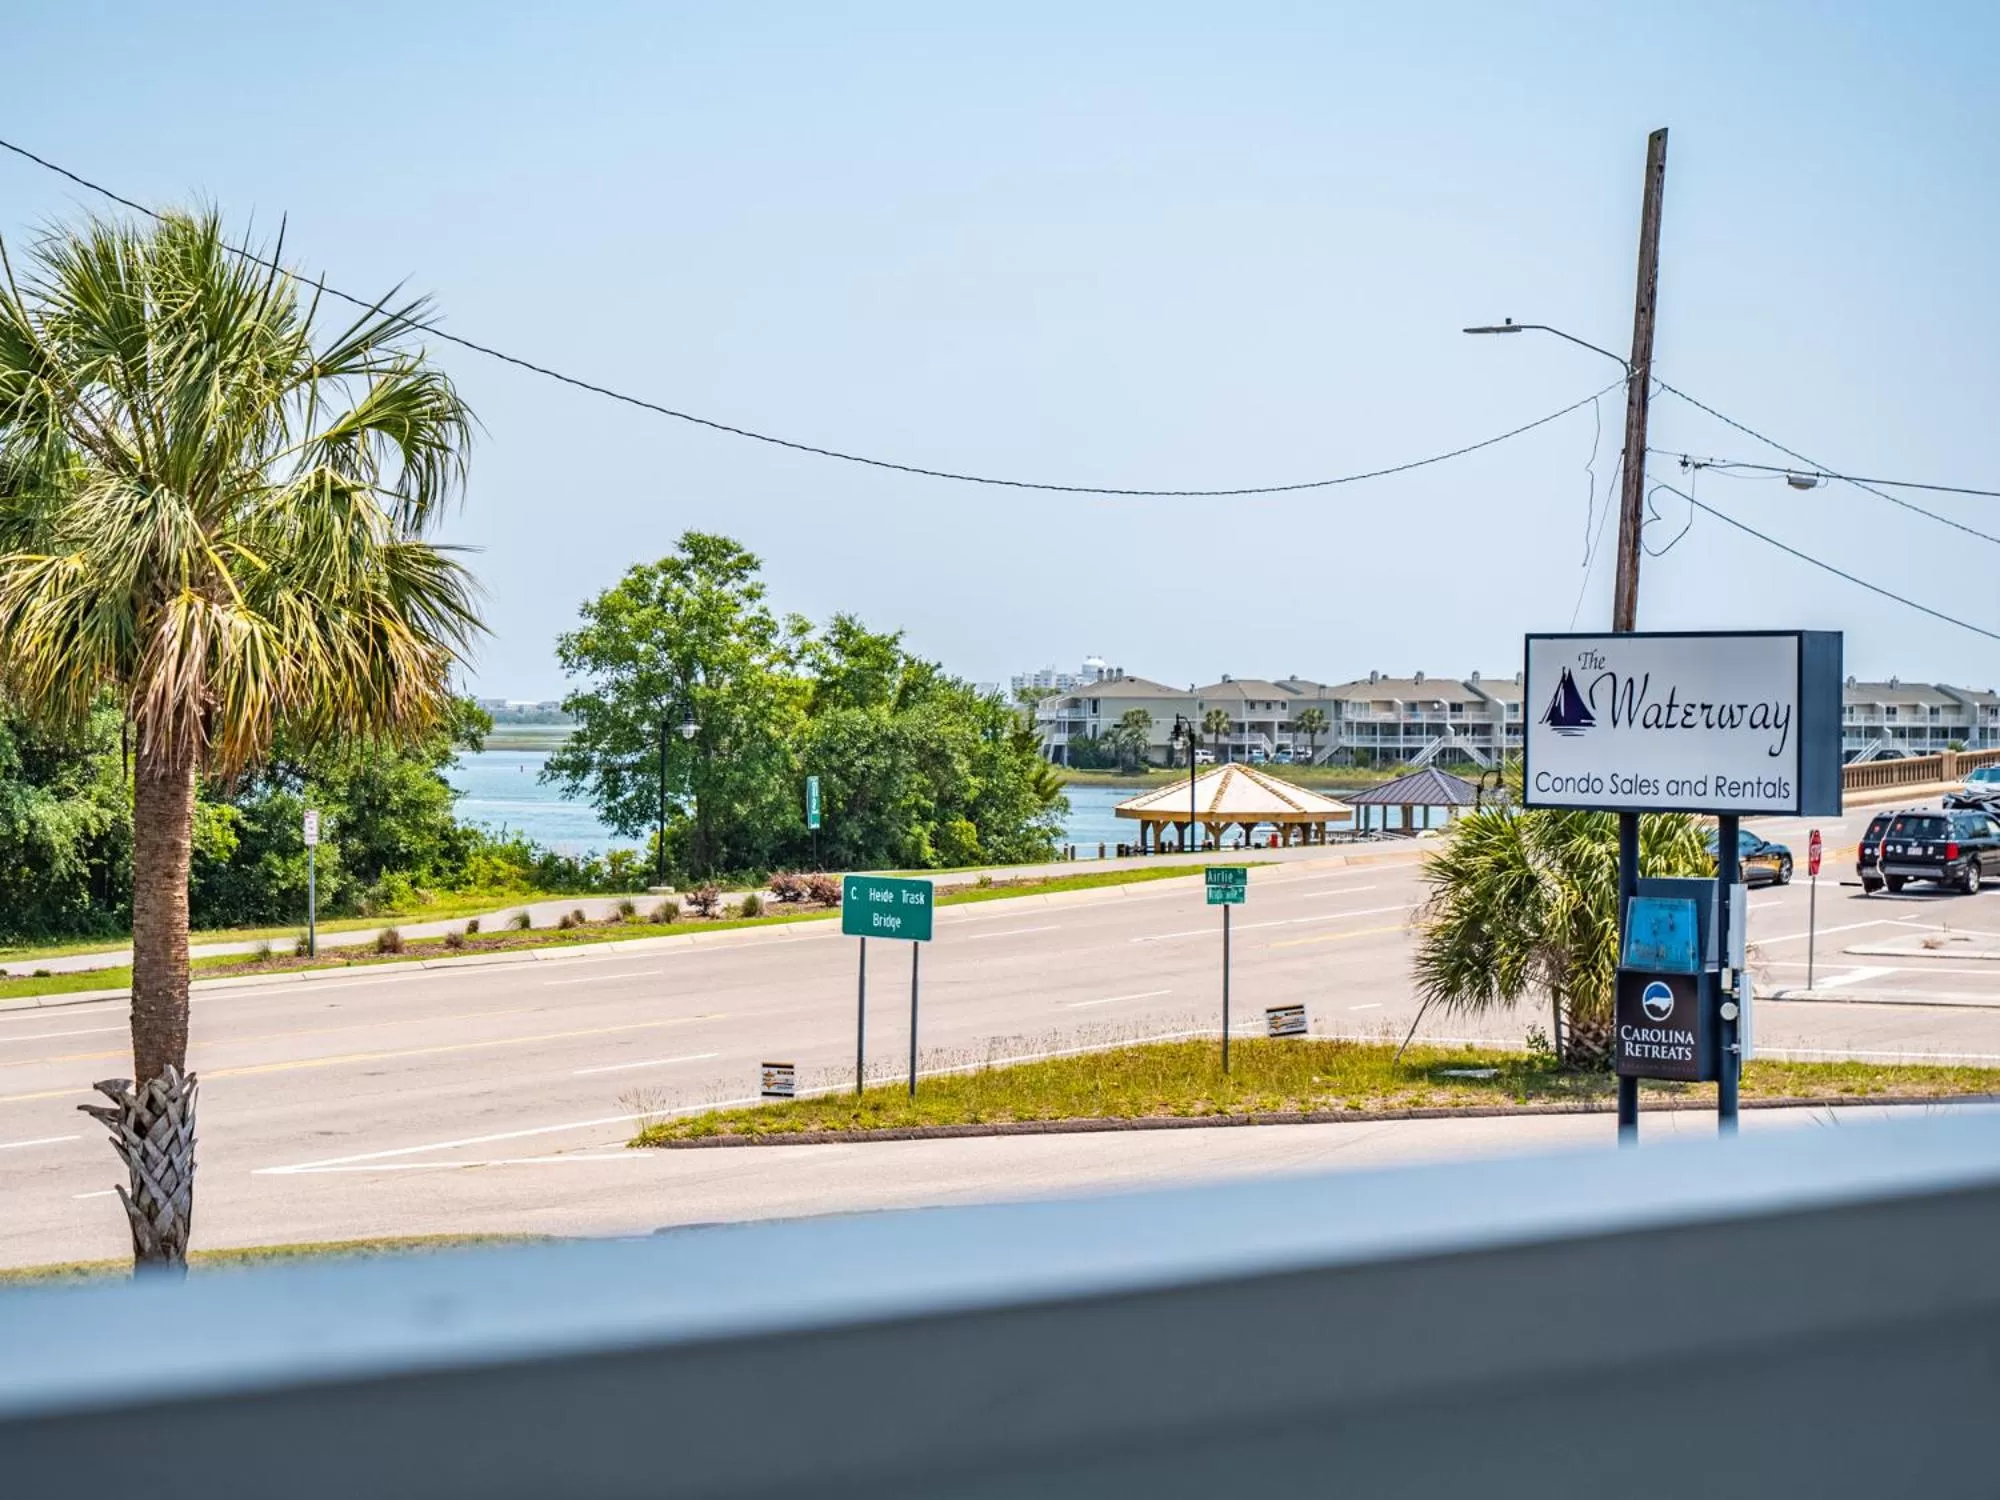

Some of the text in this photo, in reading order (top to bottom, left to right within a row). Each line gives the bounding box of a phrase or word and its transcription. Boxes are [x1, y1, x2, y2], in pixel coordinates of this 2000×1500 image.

[1578, 649, 1605, 670] The
[1589, 672, 1790, 757] Waterway
[1535, 771, 1790, 799] Condo Sales and Rentals
[1207, 870, 1234, 884] Airlie
[869, 887, 895, 903] Heide
[901, 889, 925, 905] Trask
[872, 912, 902, 932] Bridge
[1621, 1025, 1695, 1045] CAROLINA
[1625, 1041, 1692, 1061] RETREATS
